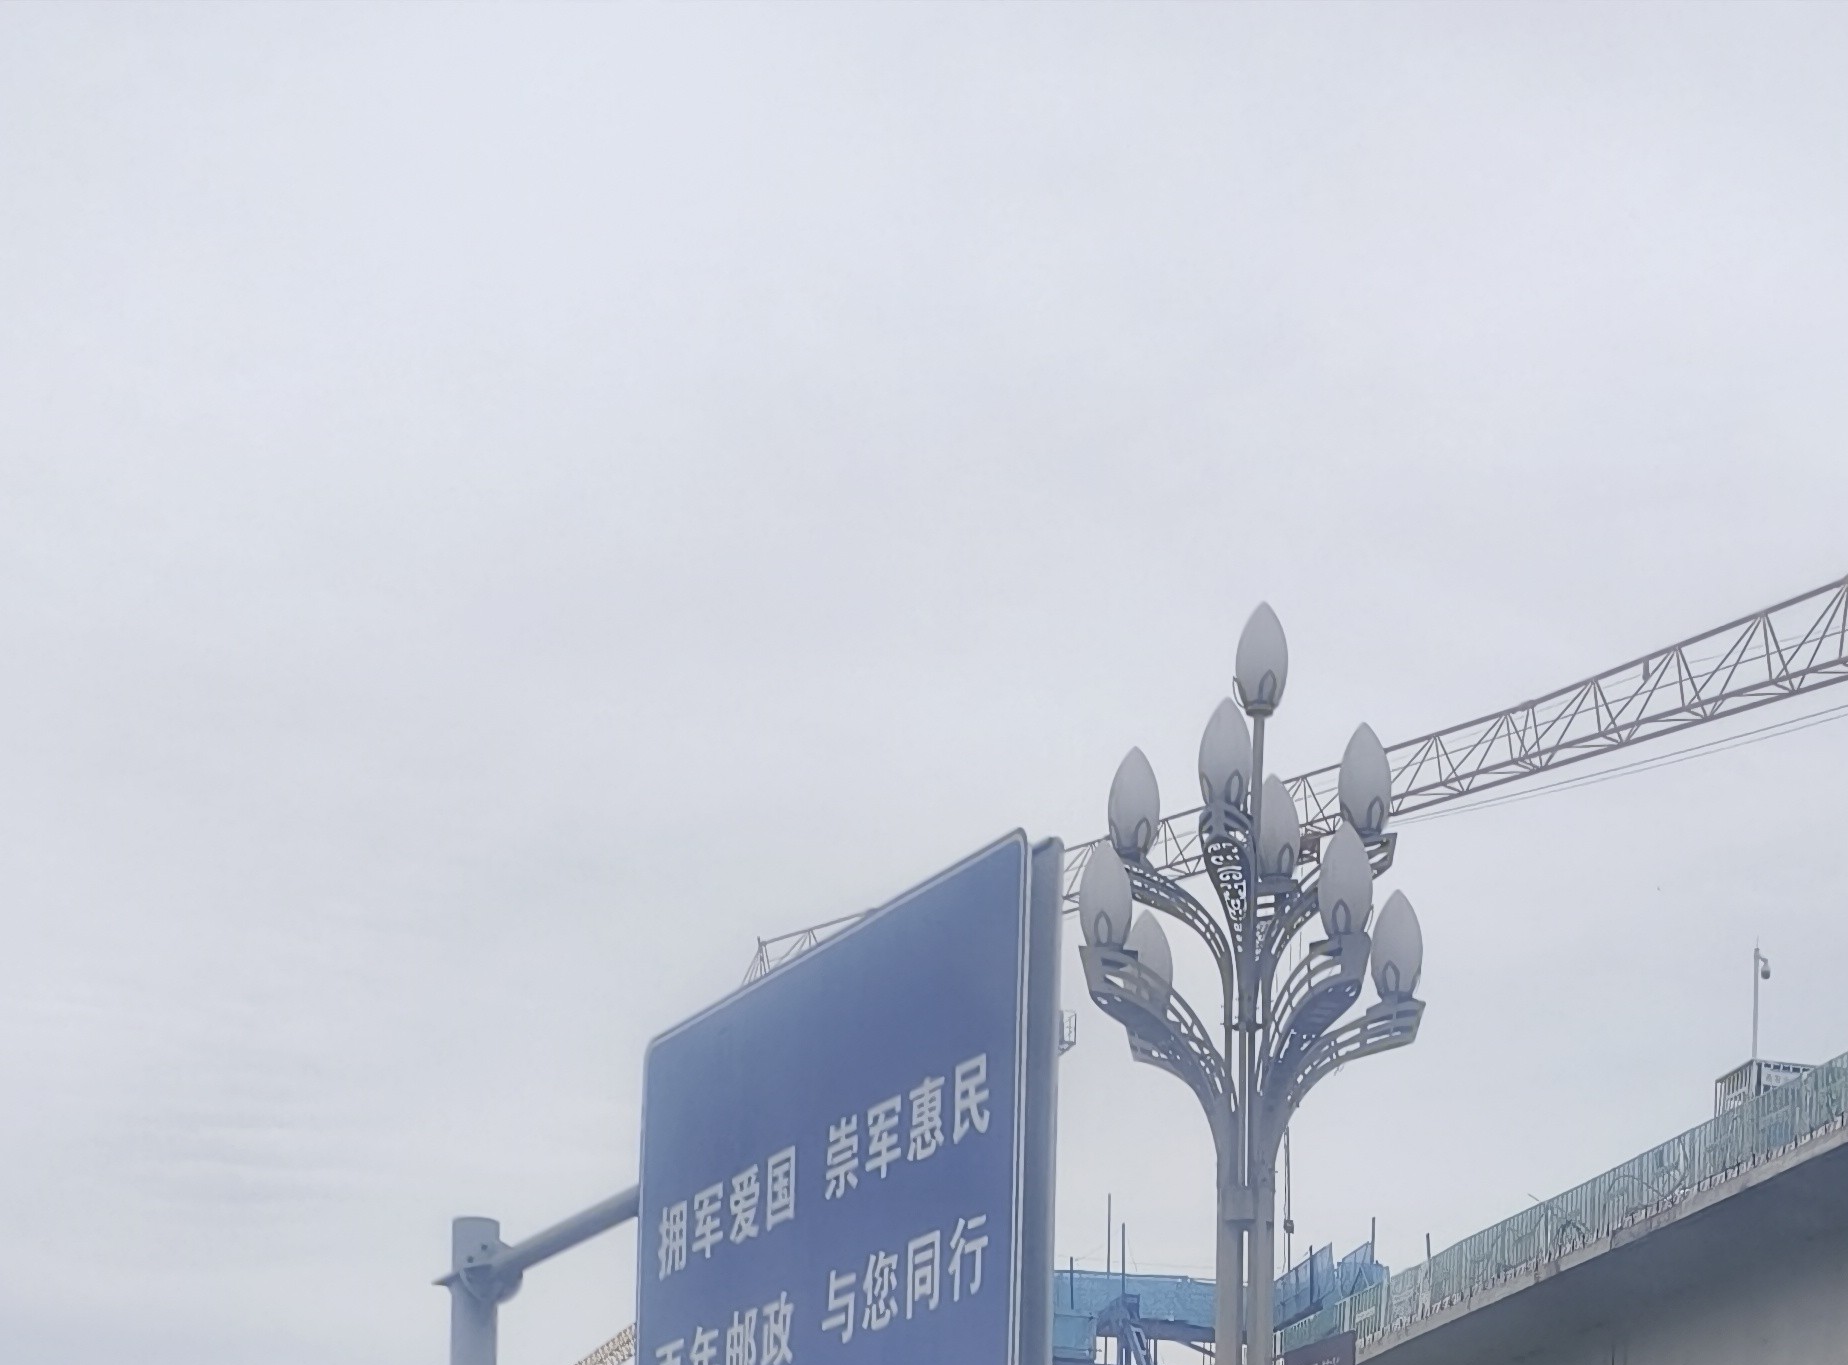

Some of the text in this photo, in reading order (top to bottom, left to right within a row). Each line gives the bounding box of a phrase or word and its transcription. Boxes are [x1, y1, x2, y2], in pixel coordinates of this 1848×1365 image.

[658, 1052, 990, 1281] 拥军爱国 崇军惠民
[821, 1214, 989, 1344] 与您同行
